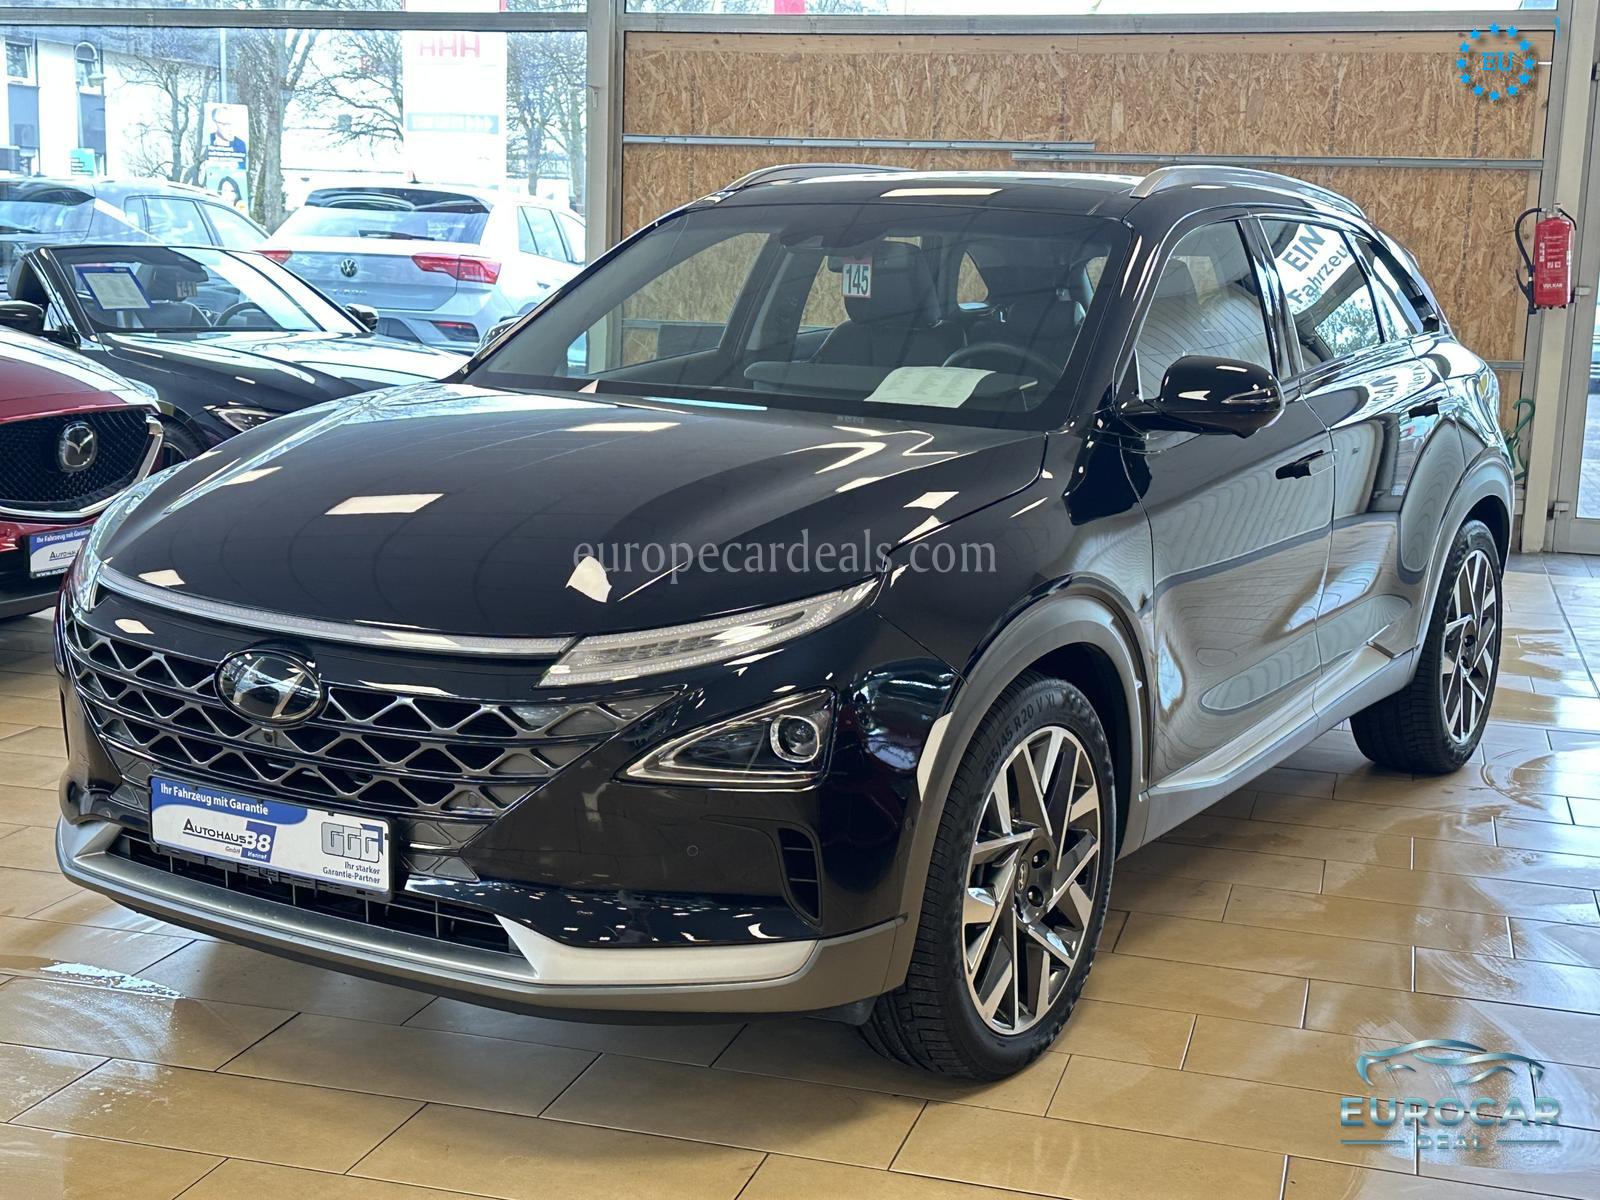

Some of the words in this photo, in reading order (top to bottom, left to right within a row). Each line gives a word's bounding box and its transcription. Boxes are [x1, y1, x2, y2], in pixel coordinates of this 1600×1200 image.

[845, 264, 870, 296] 145
[160, 783, 172, 795] Ihr
[173, 786, 212, 806] Fahrzeug
[213, 796, 228, 808] mit
[229, 799, 269, 815] Garantie
[322, 866, 380, 884] Garantie-Partner
[344, 861, 354, 870] Ihr
[355, 865, 380, 875] starker
